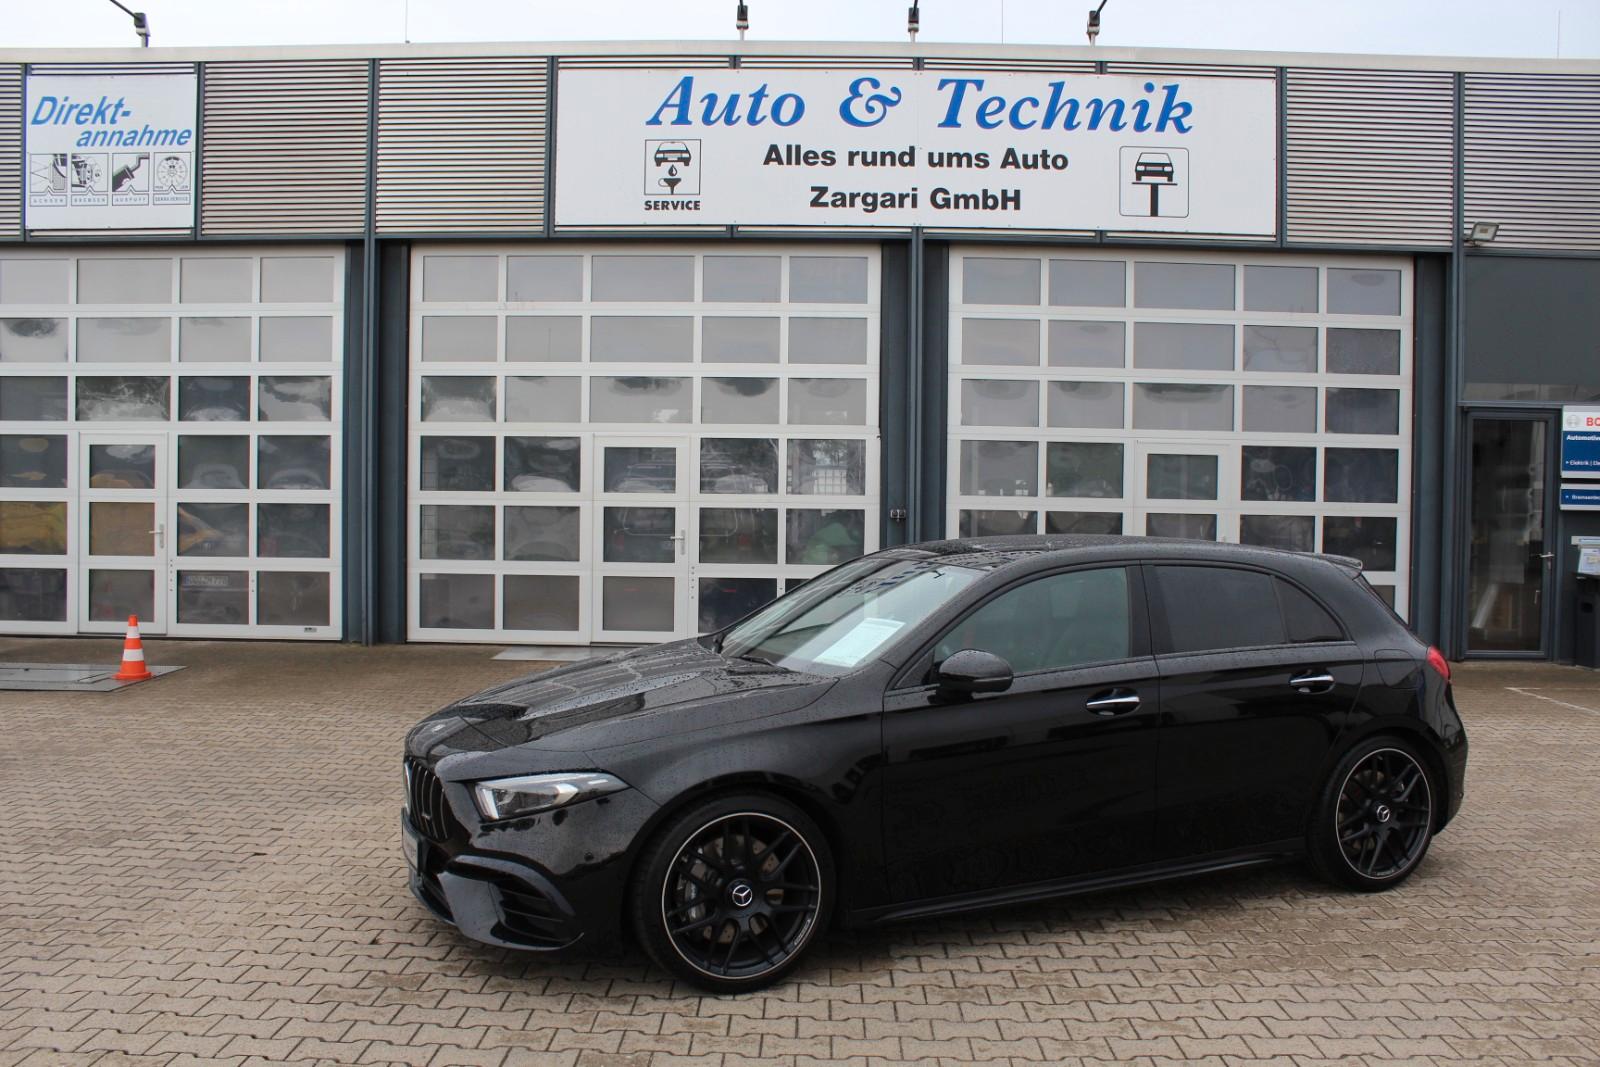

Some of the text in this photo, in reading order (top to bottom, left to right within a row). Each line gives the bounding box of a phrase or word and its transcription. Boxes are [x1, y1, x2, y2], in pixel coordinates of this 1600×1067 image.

[31, 96, 132, 126] Direkt-
[645, 75, 1195, 135] Auto & Technik
[76, 124, 192, 147] annahme
[763, 144, 1069, 171] Alles rund ums Auto
[644, 200, 701, 211] SERVICE
[810, 186, 1021, 214] Zargari GmbH
